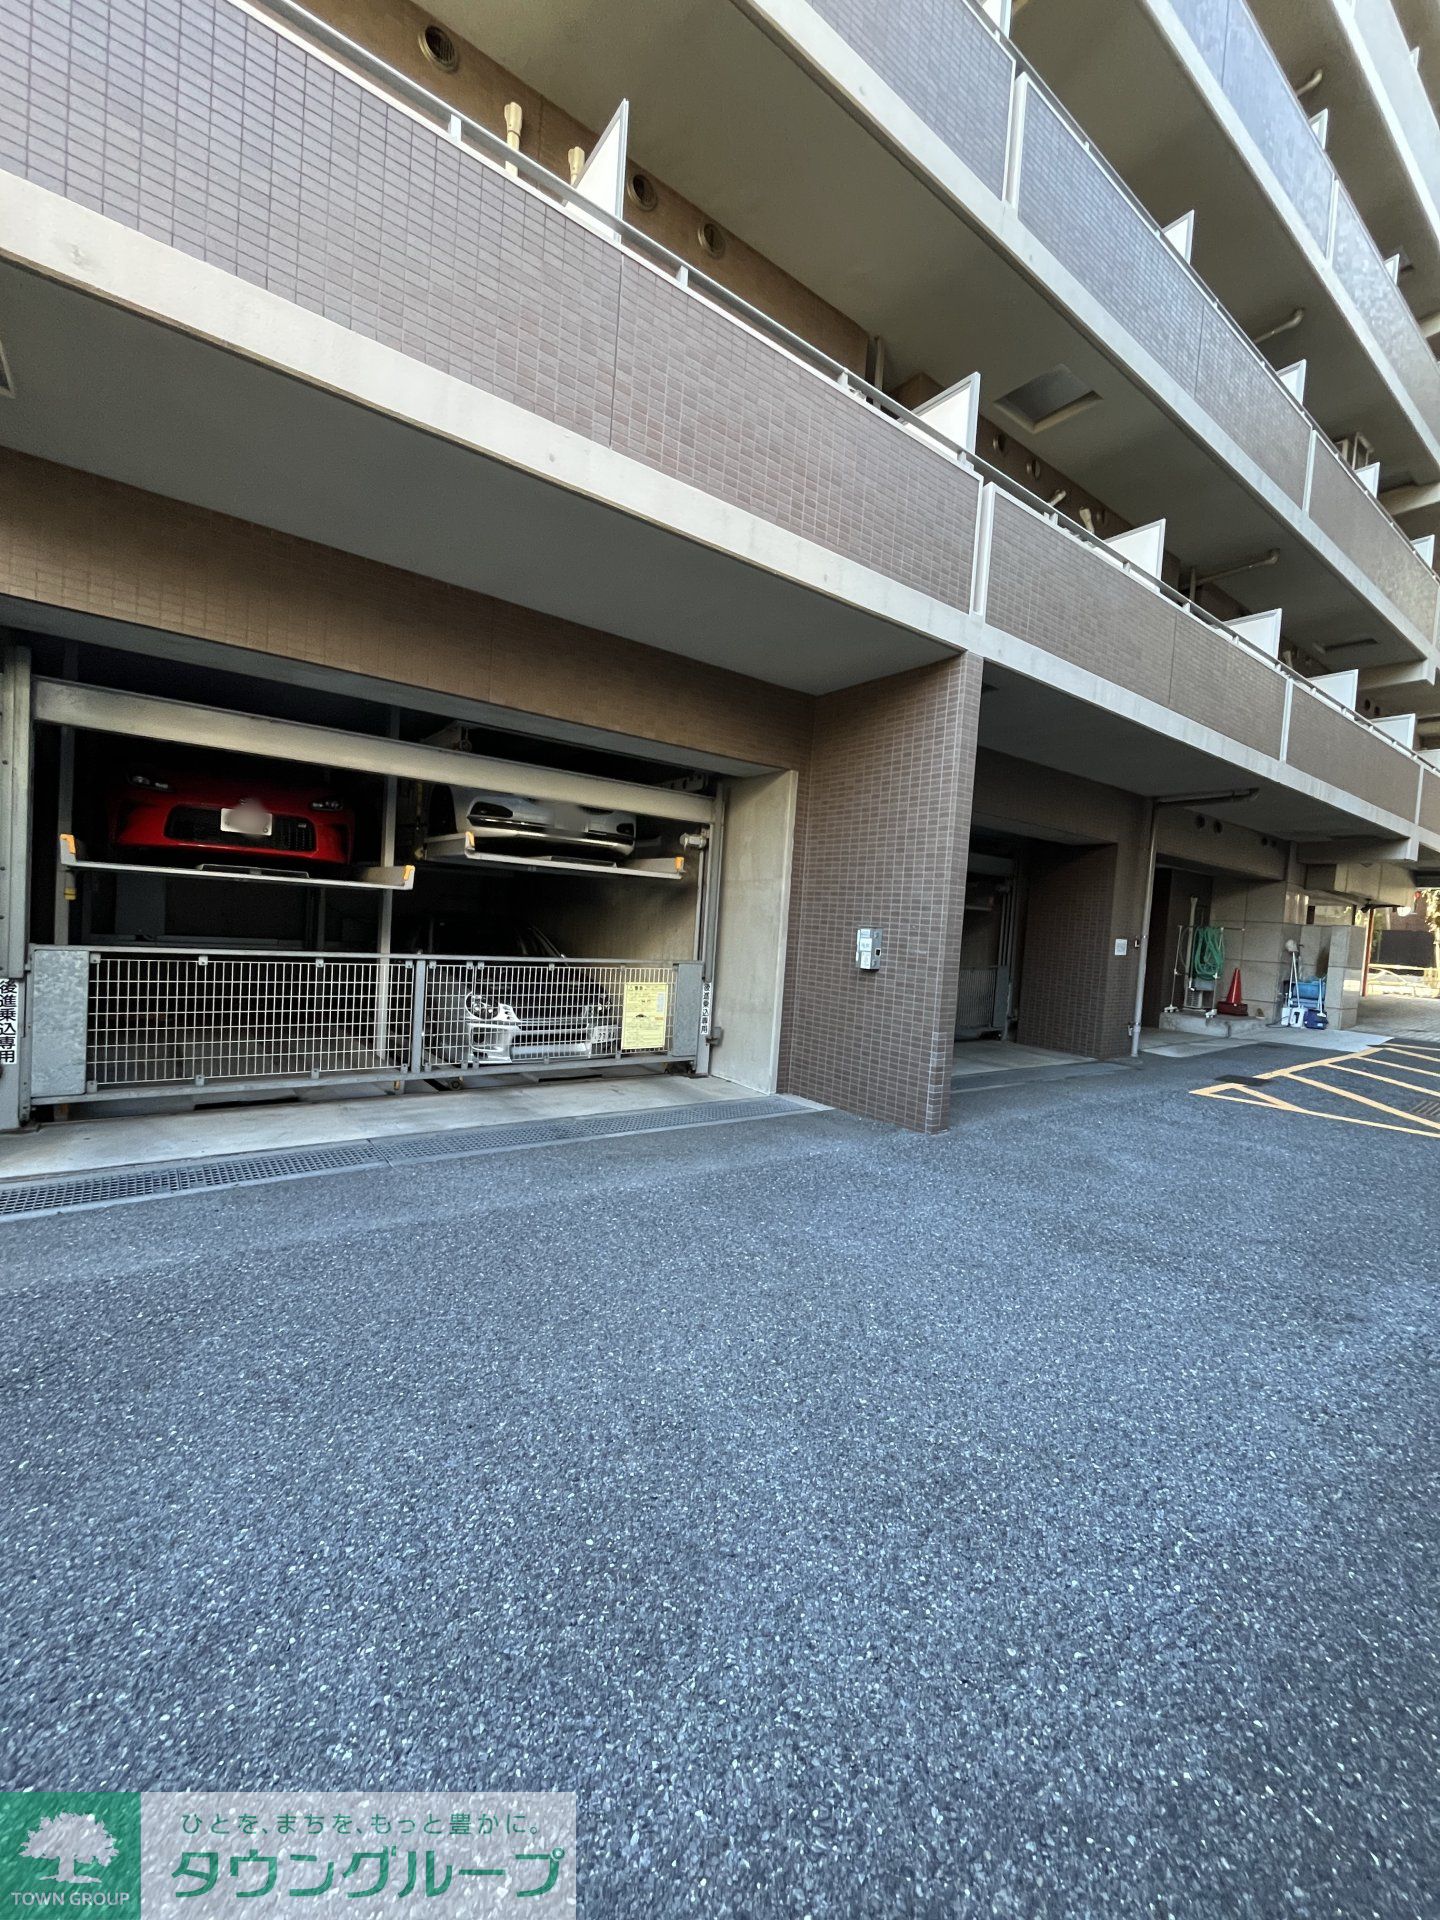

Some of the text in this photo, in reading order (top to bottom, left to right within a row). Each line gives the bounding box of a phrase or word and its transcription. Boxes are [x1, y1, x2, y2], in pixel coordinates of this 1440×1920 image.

[0, 980, 17, 1063] 後進乗込専用
